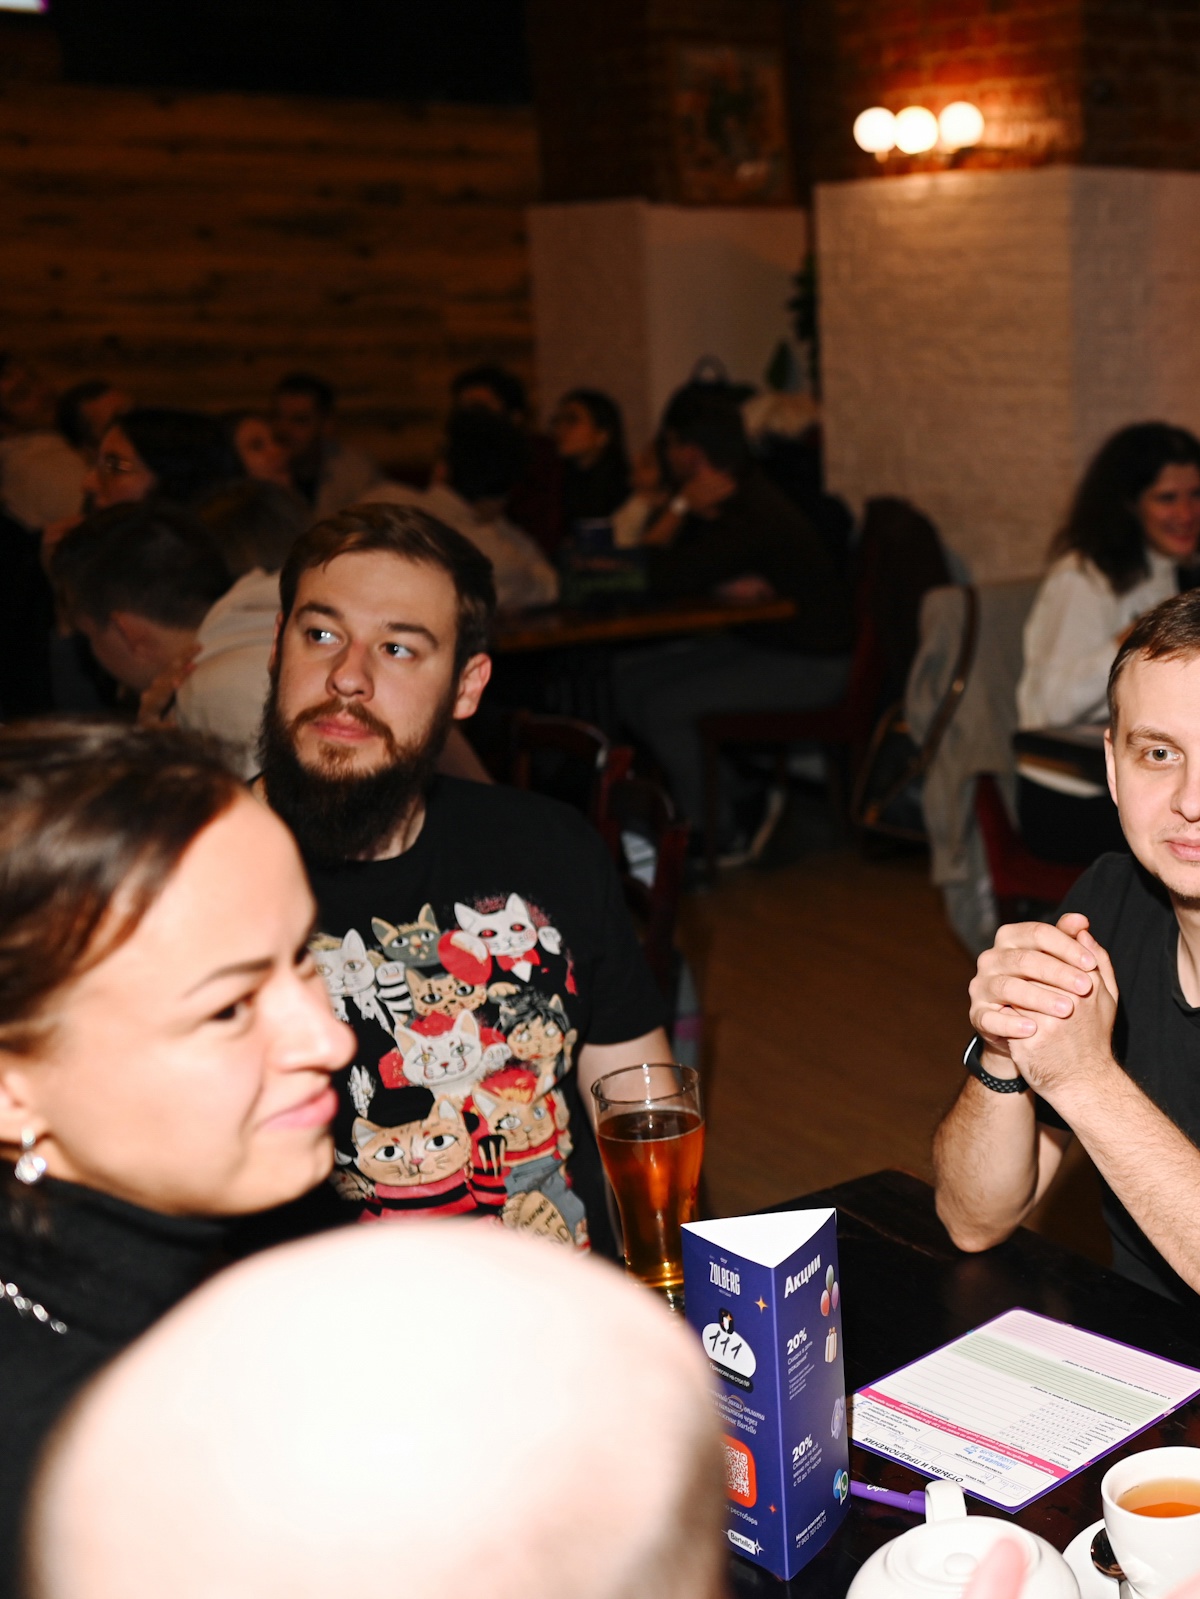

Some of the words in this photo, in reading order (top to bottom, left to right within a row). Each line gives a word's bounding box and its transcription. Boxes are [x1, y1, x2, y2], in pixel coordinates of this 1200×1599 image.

[709, 1261, 740, 1296] ZOLBERG
[784, 1254, 821, 1299] Акции
[709, 1330, 742, 1360] 111
[787, 1327, 807, 1356] 20%
[792, 1433, 812, 1463] 20%
[862, 1437, 922, 1465] ПРЕДЛОЖЕНИЯ
[928, 1465, 964, 1483] ОТЗЫВЫ
[731, 1532, 752, 1549] Bartello
